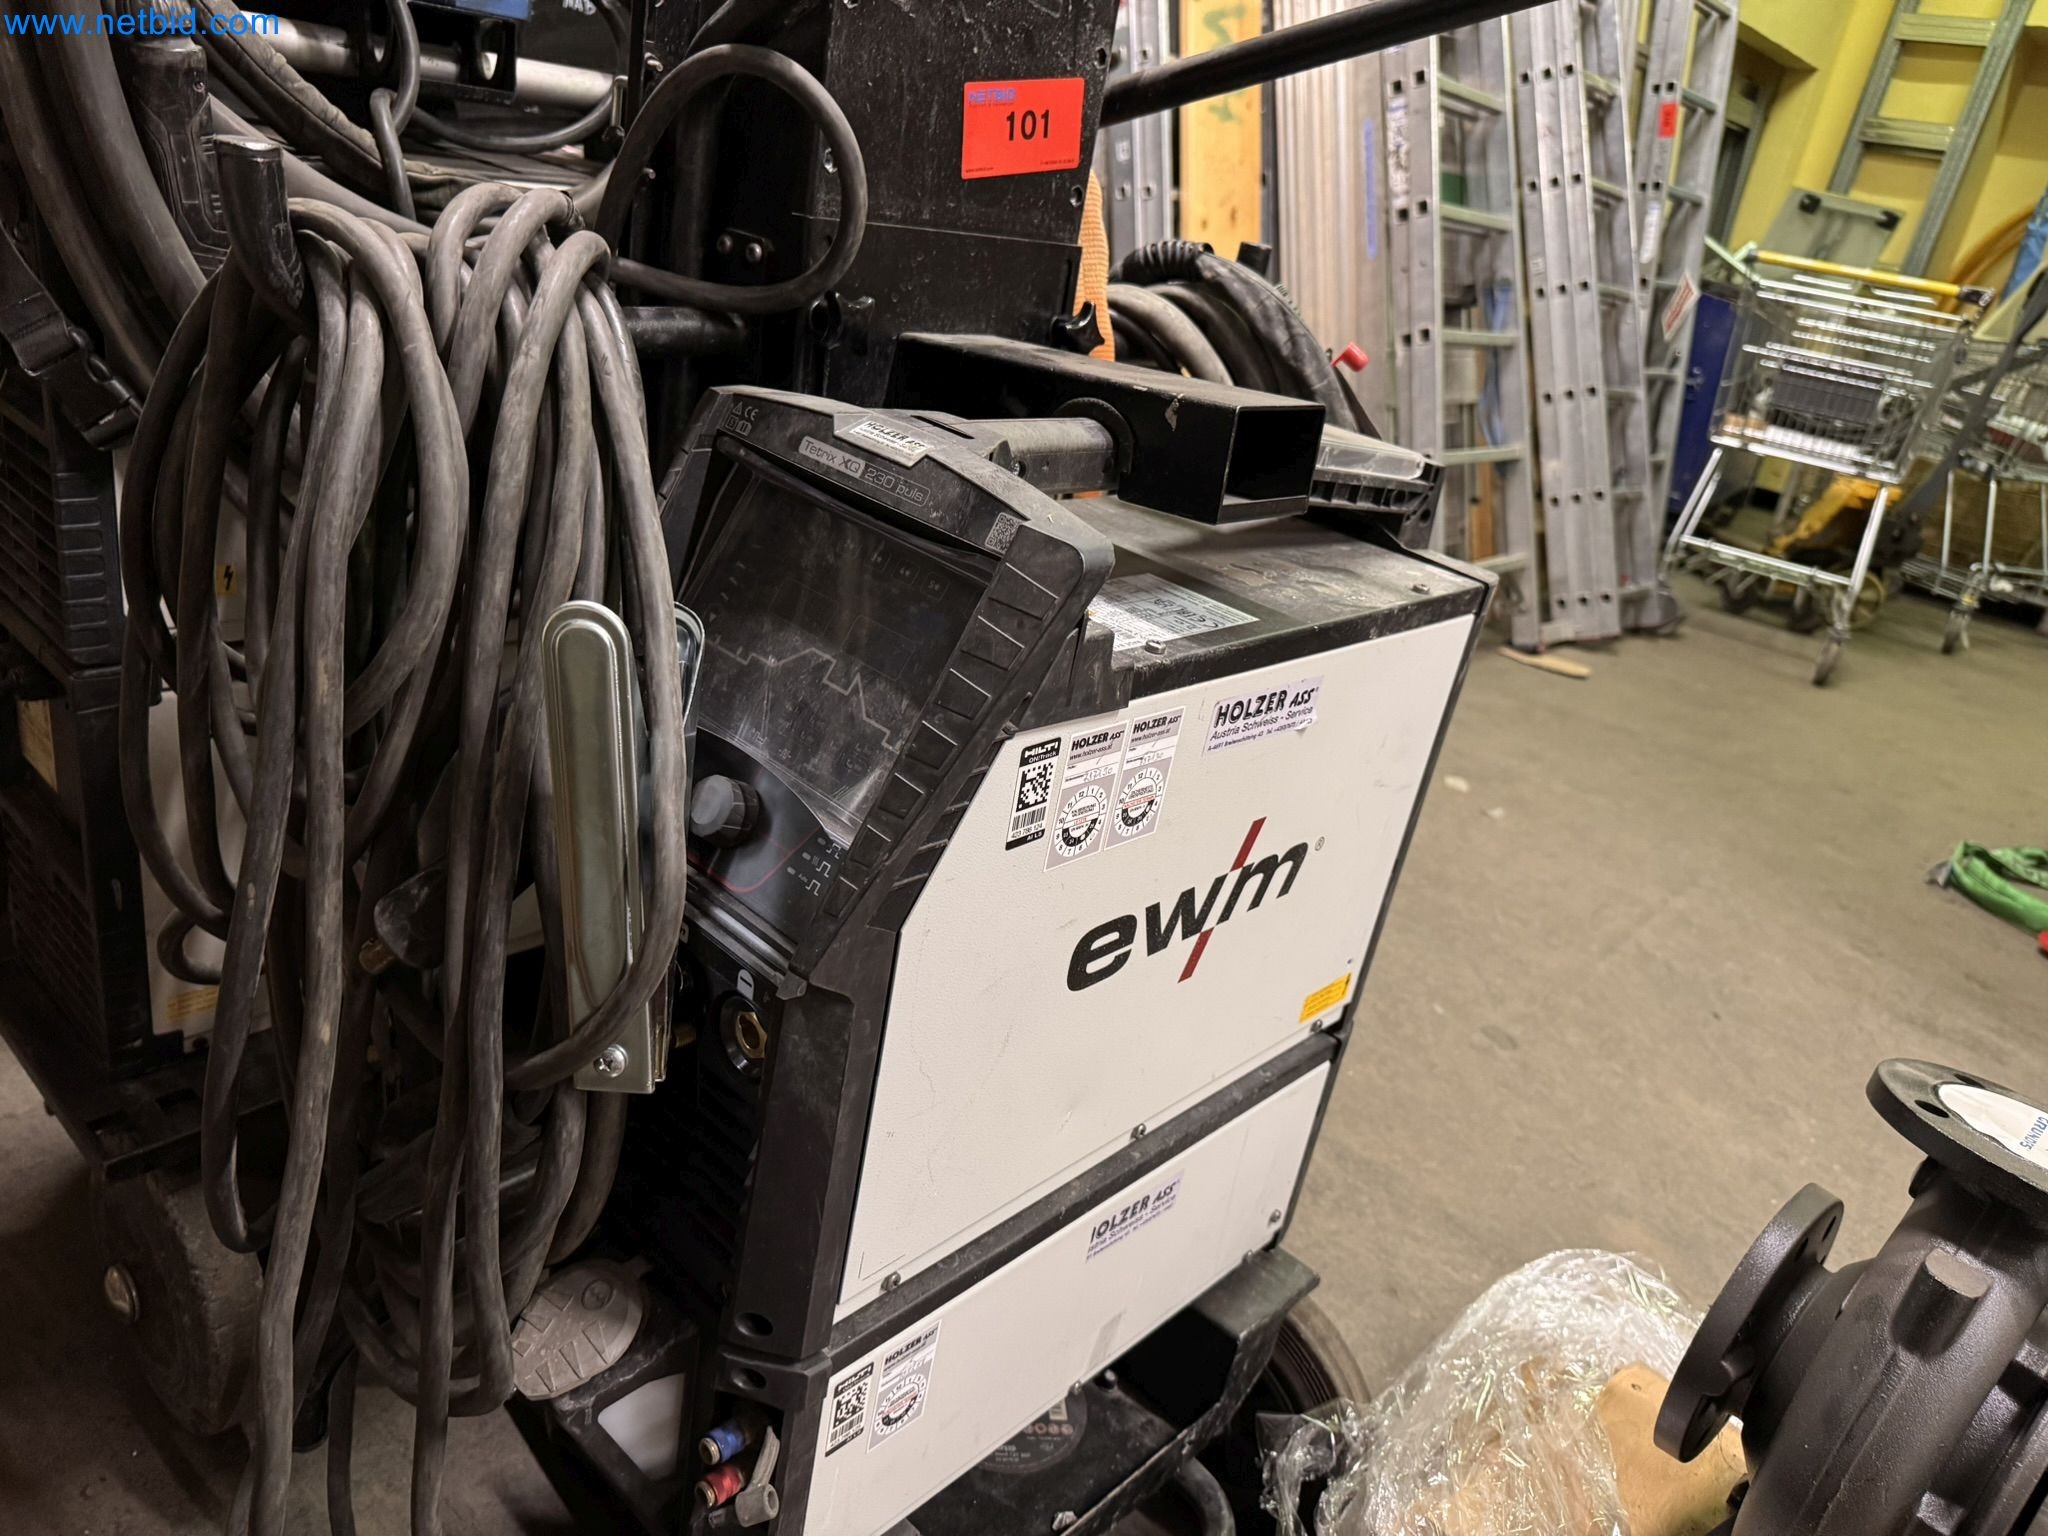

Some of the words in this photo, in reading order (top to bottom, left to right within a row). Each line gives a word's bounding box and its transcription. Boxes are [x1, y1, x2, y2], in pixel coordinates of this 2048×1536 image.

[1006, 109, 1050, 141] 101
[804, 439, 836, 464] Tetrix
[839, 455, 862, 474] XQ
[864, 467, 895, 489] 230
[896, 484, 925, 502] puls
[1209, 726, 1240, 741] Austria
[1241, 716, 1279, 733] Schweiss
[1285, 706, 1313, 720] Service
[1213, 690, 1288, 728] HOLZER
[1289, 688, 1315, 708] ASS
[1071, 732, 1109, 751] HOLZER
[1133, 716, 1168, 734] HOLZER
[1024, 741, 1059, 758] HILTI
[1066, 842, 1309, 992] ewm
